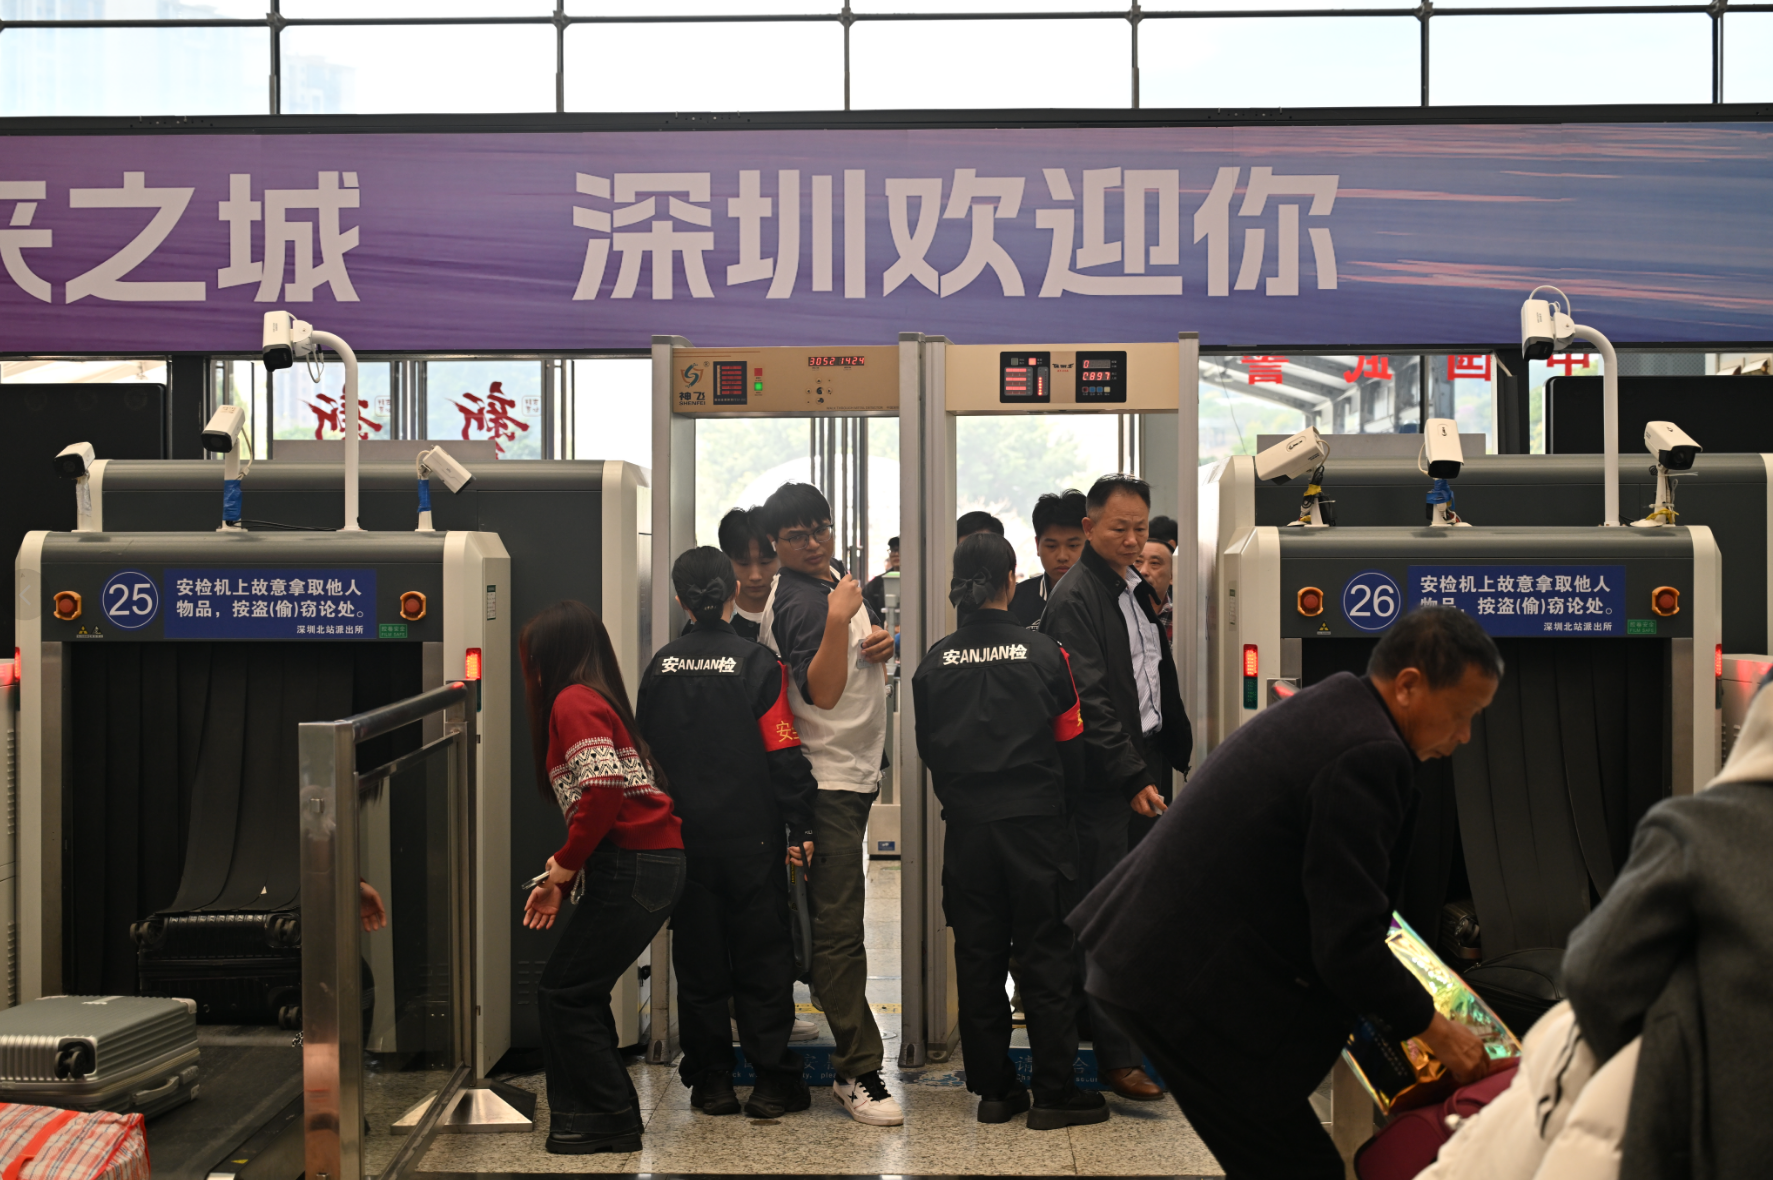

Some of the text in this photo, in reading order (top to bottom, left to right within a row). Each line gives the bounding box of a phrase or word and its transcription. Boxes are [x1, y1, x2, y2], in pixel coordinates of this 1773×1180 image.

[572, 166, 1340, 301] 深圳欢迎你
[809, 356, 865, 366] 3052 1424
[679, 391, 706, 401] 神飞
[176, 578, 362, 596] 安检机上故意拿取他人
[1420, 575, 1611, 593] 安检机上故意拿取他人
[108, 583, 153, 616] 25
[1349, 584, 1395, 617] 26
[296, 625, 364, 635] 深圳北站派出所
[1543, 622, 1613, 632] 深圳北站派出所
[943, 644, 1028, 665] 安ANJIAN检
[661, 656, 737, 673] 安ANJIAN检
